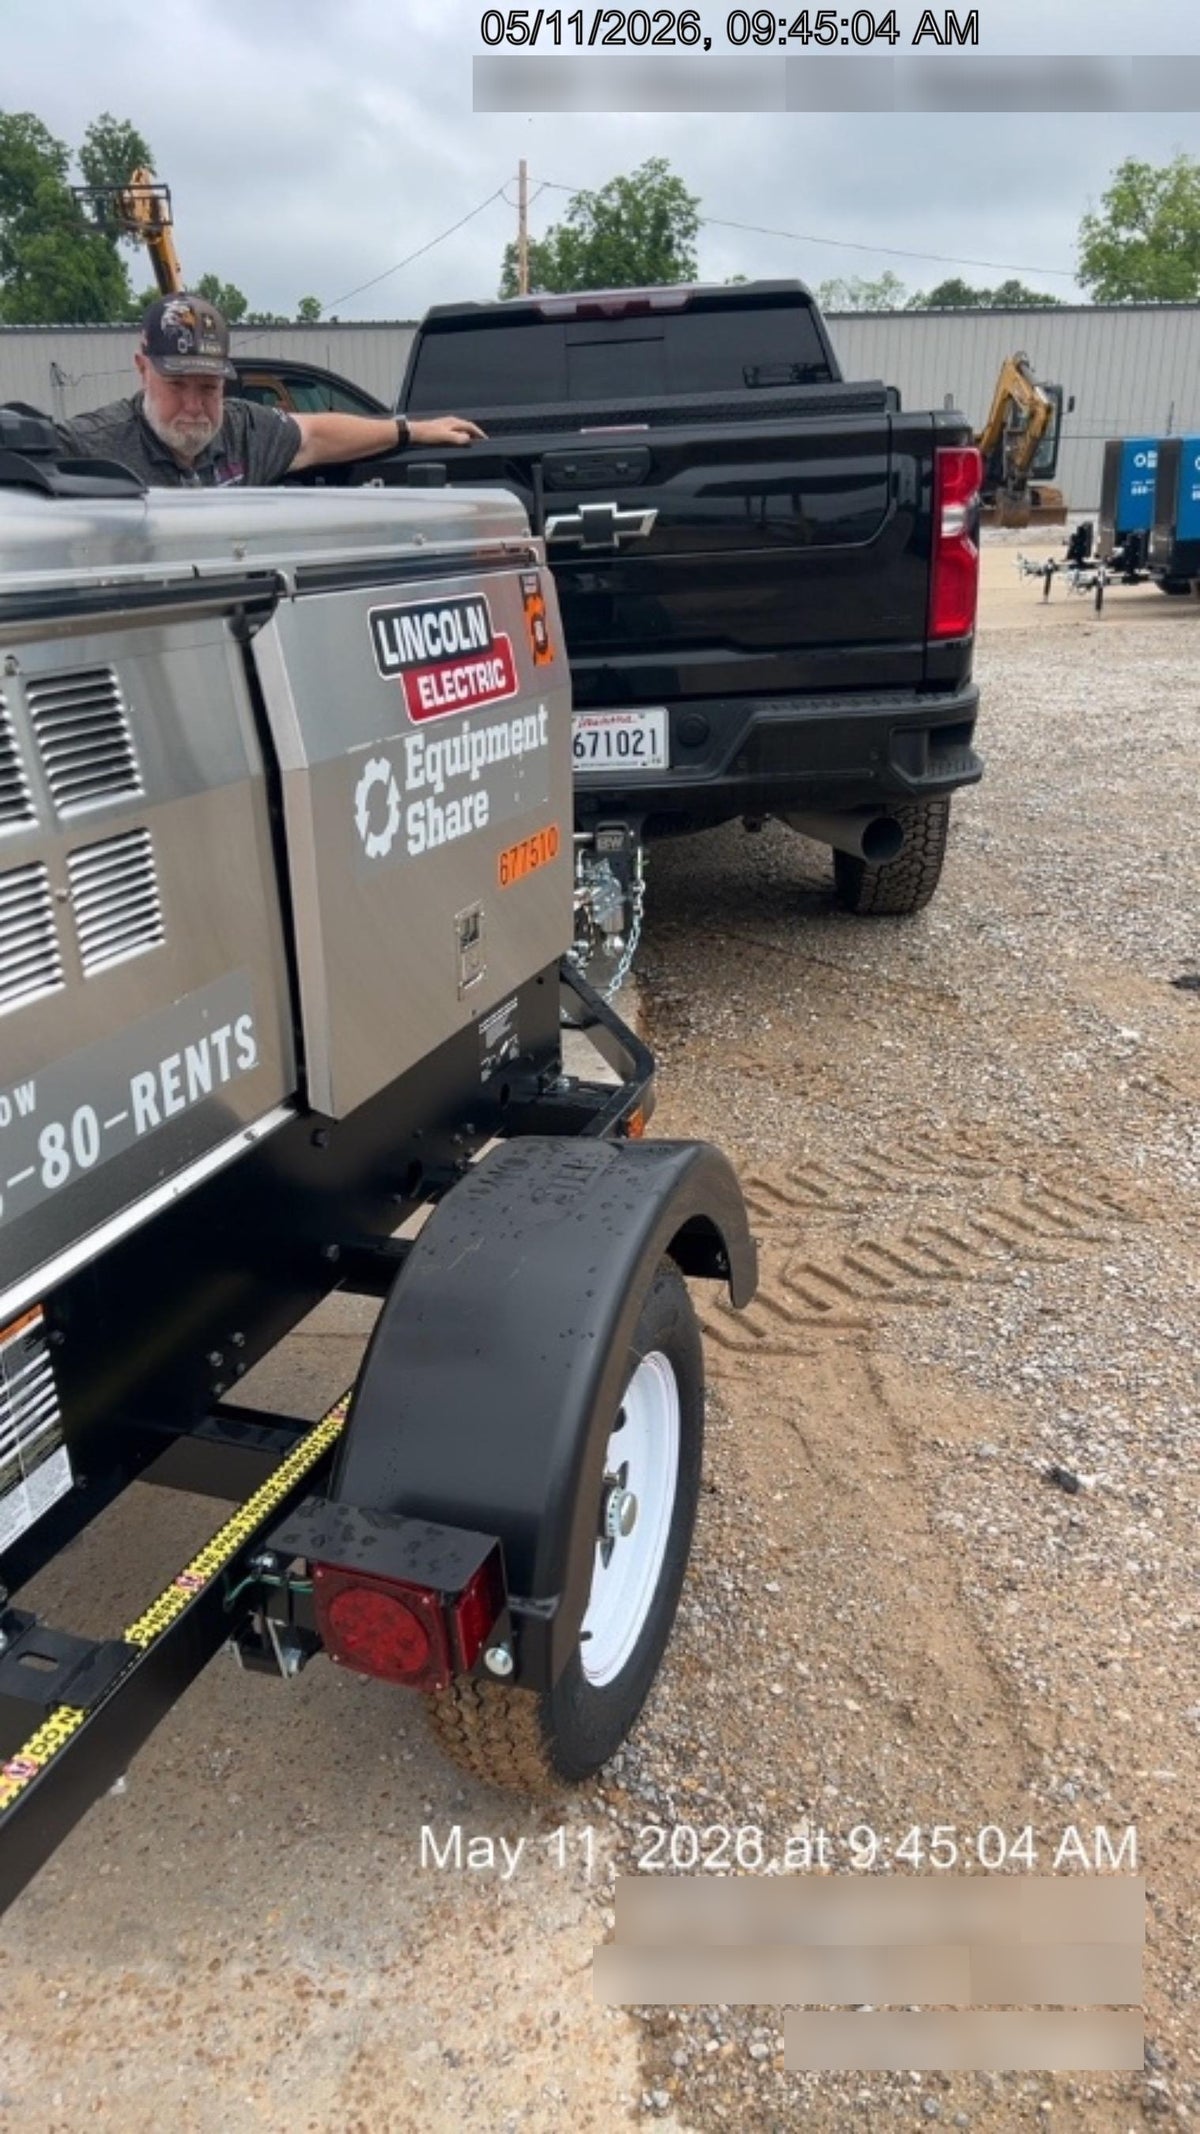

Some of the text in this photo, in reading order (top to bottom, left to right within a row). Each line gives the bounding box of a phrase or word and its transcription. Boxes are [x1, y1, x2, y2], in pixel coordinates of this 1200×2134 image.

[377, 604, 489, 666] LINCOLN
[417, 658, 507, 710] ELECTRIC
[404, 703, 549, 792] Equipment
[573, 728, 656, 758] 671021
[406, 790, 490, 857] Share
[500, 827, 558, 885] 677510
[0, 1014, 258, 1217] -80-RENTS
